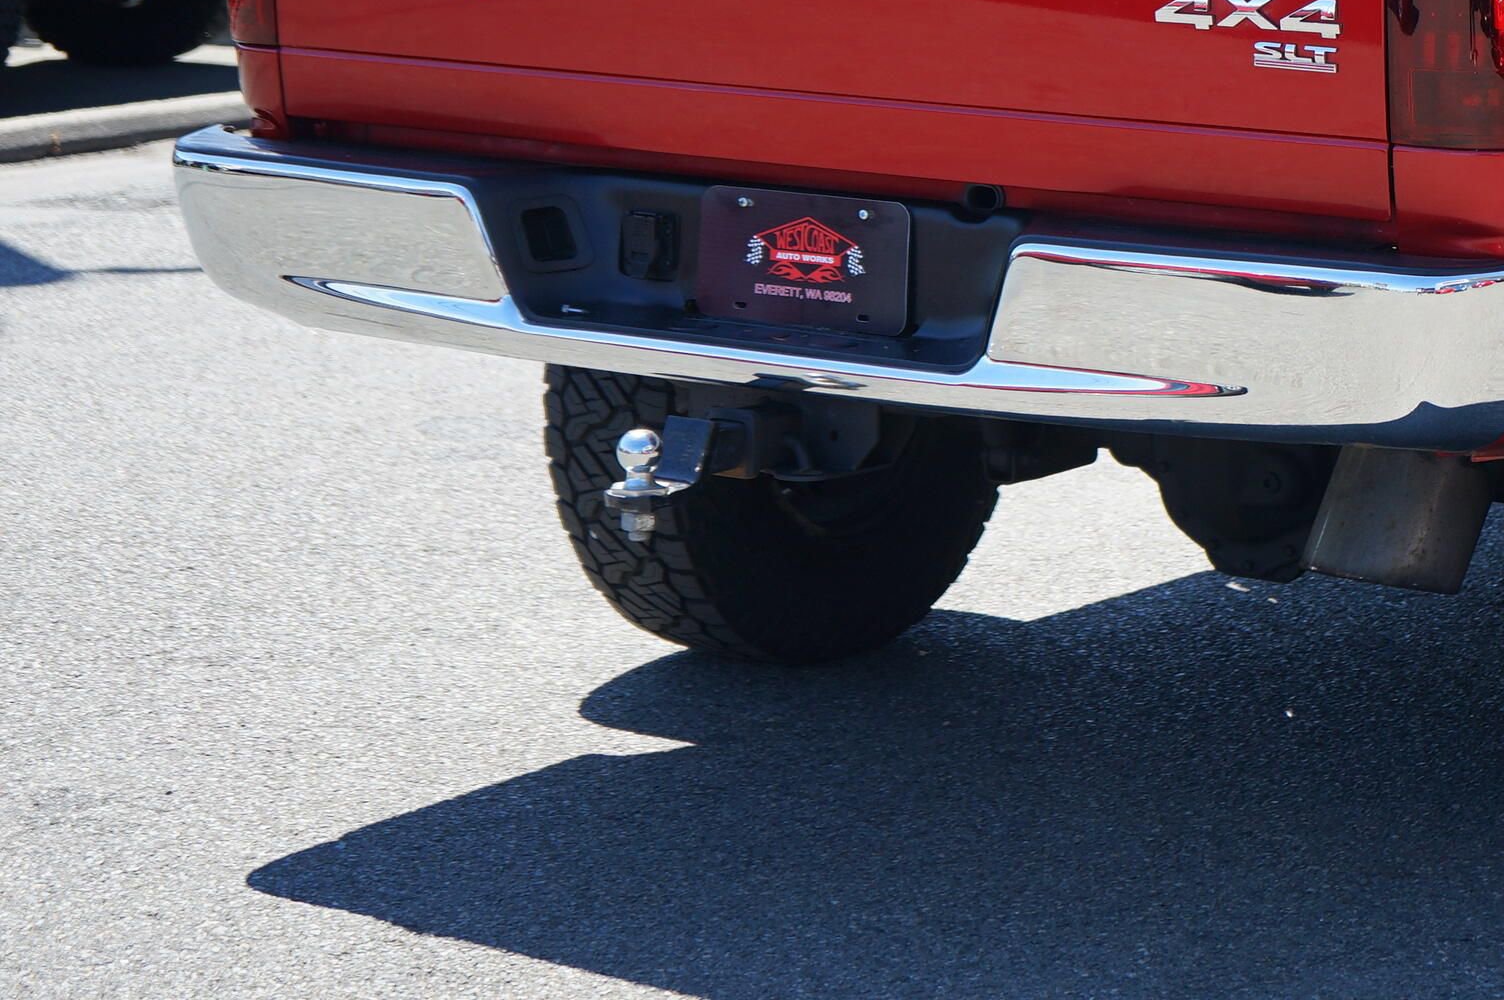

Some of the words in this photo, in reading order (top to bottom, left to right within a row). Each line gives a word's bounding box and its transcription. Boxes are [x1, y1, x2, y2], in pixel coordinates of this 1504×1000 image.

[1253, 41, 1338, 66] SLT
[776, 251, 801, 261] AUTO
[802, 254, 835, 264] WORKS
[754, 283, 804, 299] EVERETT,
[805, 288, 823, 301] WA
[823, 290, 852, 304] 98204
